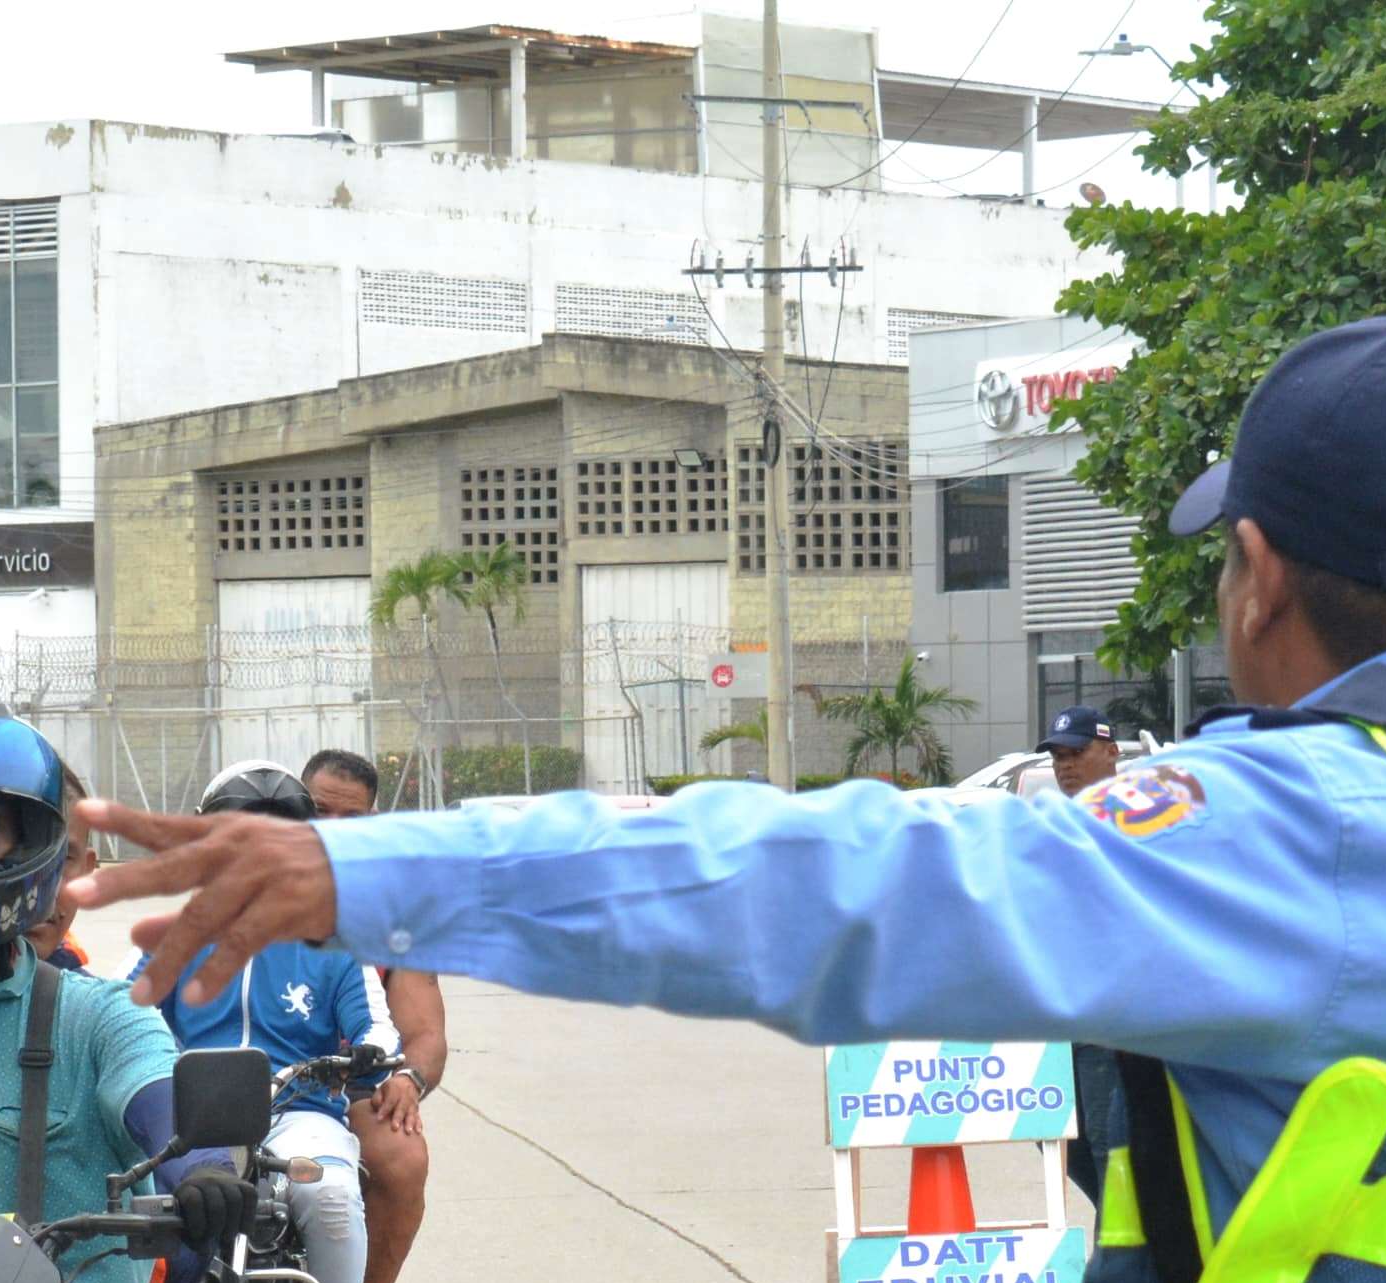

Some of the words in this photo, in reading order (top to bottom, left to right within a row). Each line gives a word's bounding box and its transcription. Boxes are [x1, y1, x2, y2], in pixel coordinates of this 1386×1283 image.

[893, 1055, 1005, 1083] PUNTO
[840, 1084, 1063, 1119] PEDAGÓGICO
[900, 1236, 1023, 1267] DATT
